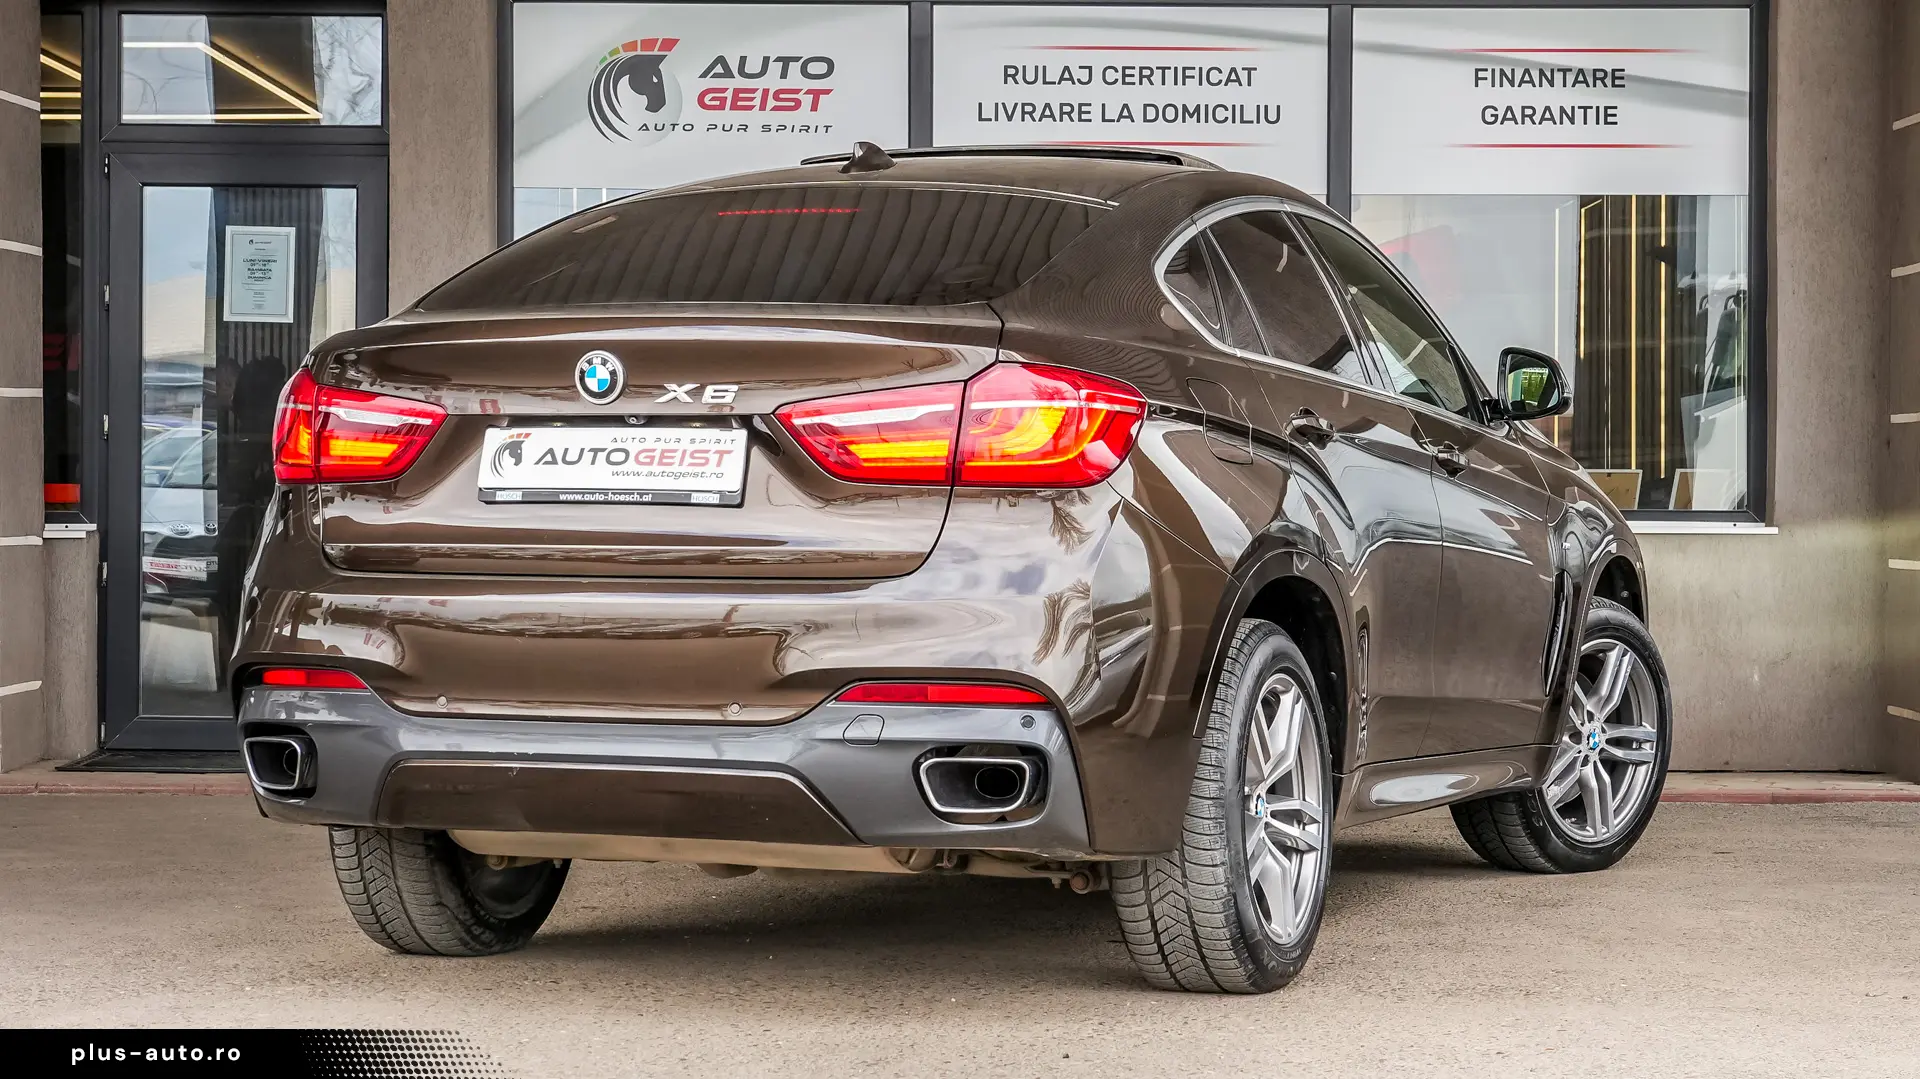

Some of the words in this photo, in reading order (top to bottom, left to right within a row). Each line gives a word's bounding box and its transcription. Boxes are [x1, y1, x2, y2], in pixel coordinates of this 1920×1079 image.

[697, 55, 835, 80] AUTO
[1003, 64, 1093, 86] RULAJ
[1101, 65, 1257, 87] CERTIFICAT
[1474, 67, 1626, 88] FINANTARE
[697, 87, 834, 112] GEIST
[977, 102, 1092, 123] LIVRARE
[1100, 103, 1135, 123] LA
[1142, 103, 1281, 125] DOMICILIU
[1480, 105, 1618, 126] GARANTIE
[637, 123, 694, 132] AUTO
[706, 123, 748, 133] PUR
[761, 124, 833, 134] SPIRIT
[581, 356, 615, 372] BMW
[611, 470, 724, 480] www.autogeist.ro
[559, 492, 653, 502] www.auto-hoesch.at
